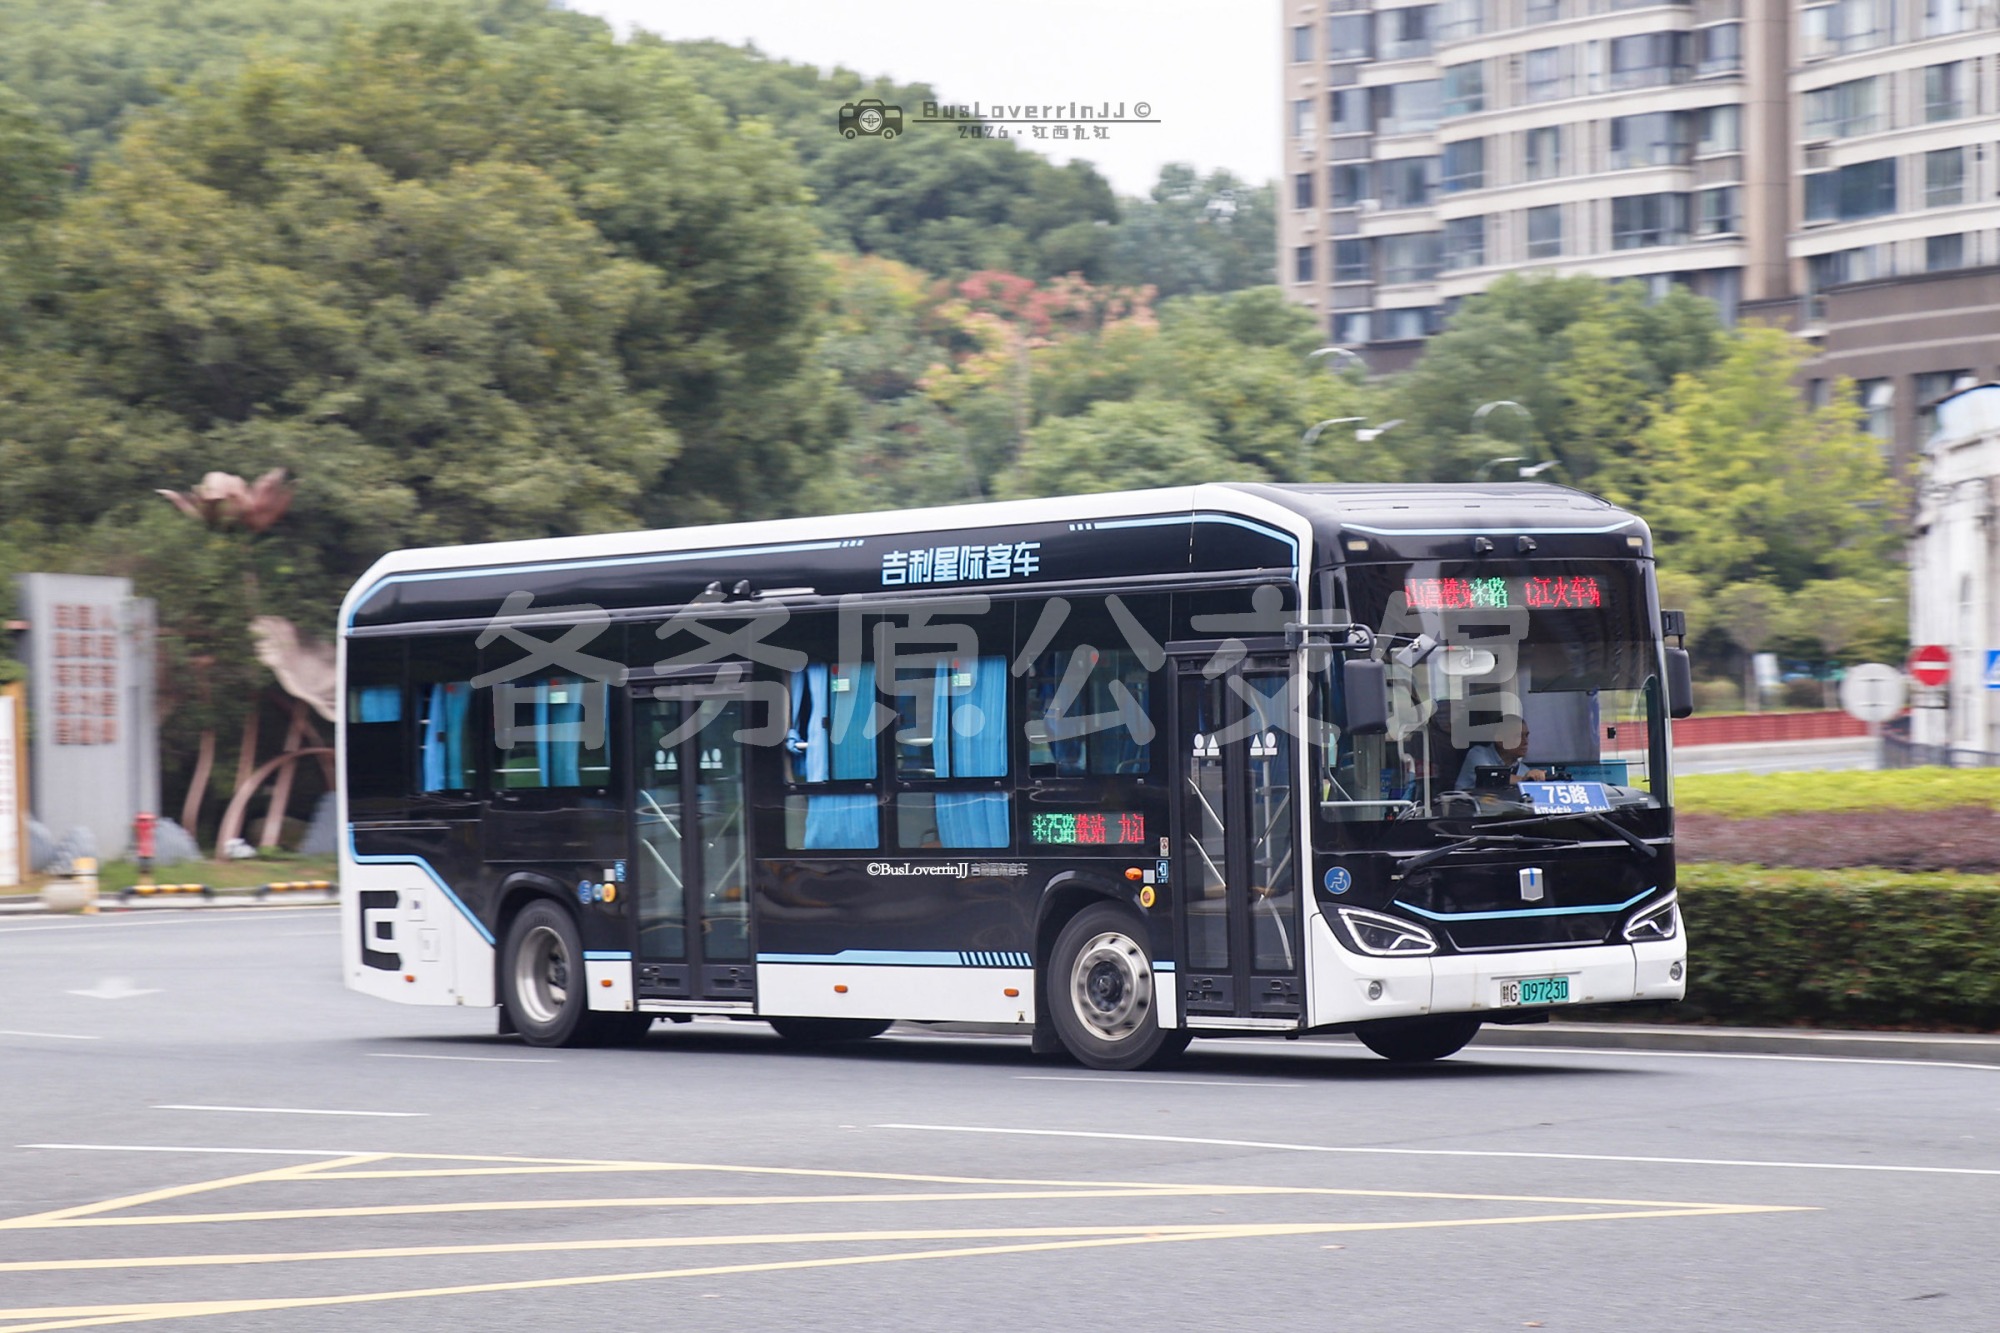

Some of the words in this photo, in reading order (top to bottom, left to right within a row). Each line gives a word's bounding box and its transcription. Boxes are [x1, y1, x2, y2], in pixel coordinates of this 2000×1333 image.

[881, 541, 1041, 585] 吉利星际客车
[1541, 785, 1590, 805] 75路
